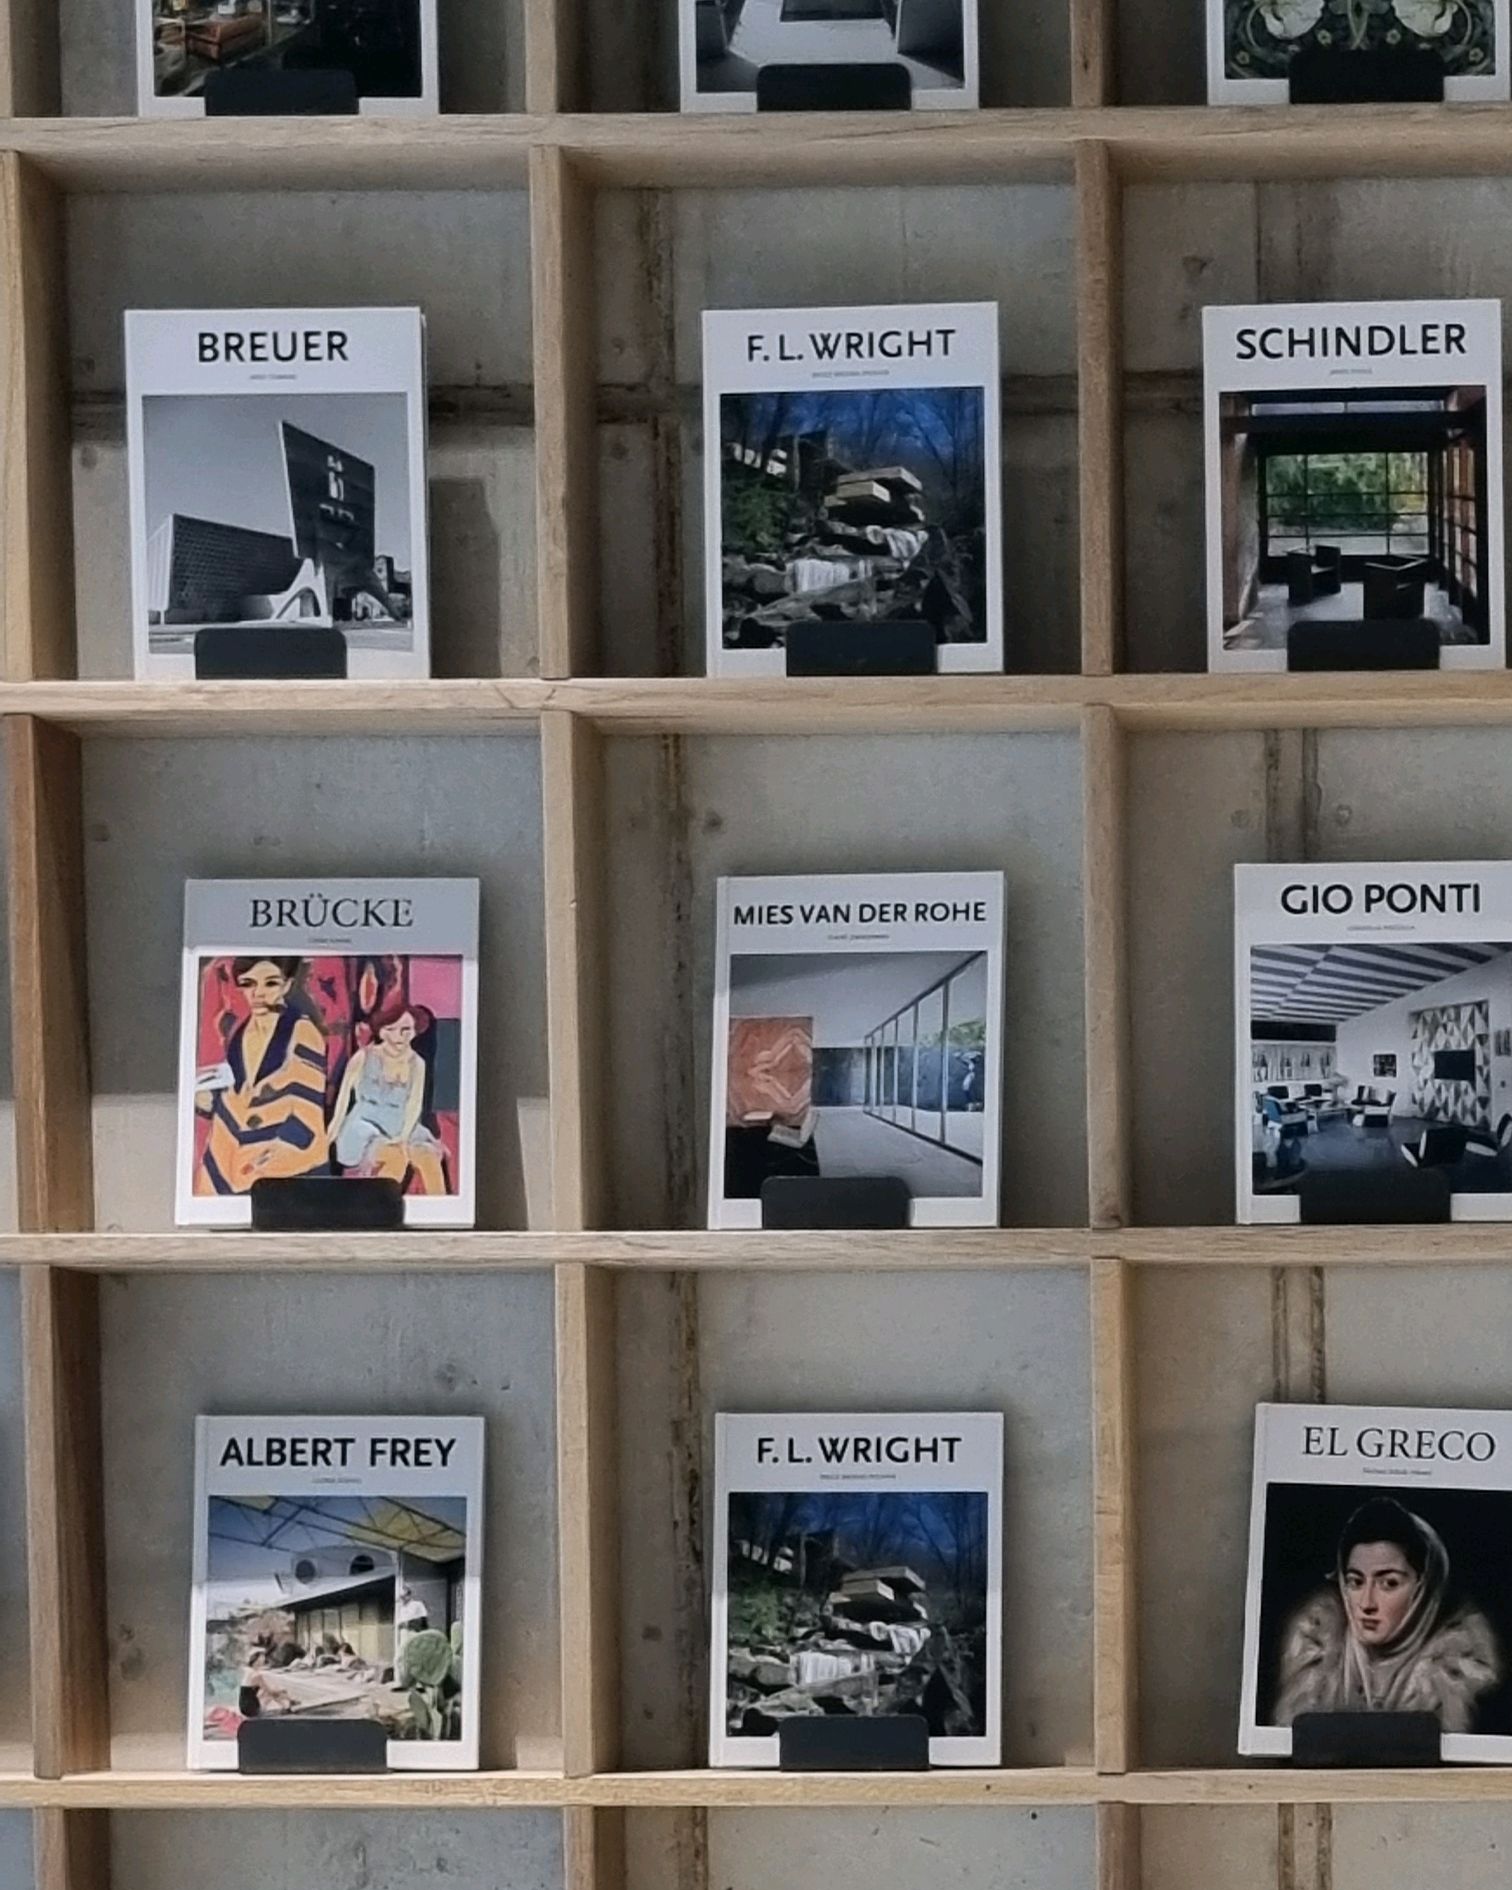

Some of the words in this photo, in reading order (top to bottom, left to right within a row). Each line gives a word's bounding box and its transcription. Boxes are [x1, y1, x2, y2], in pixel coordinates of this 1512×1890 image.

[198, 330, 350, 363] BREUER
[1234, 323, 1467, 360] SCHINDLER
[248, 892, 415, 928] BRÜCKE
[733, 904, 794, 926] MIES
[799, 903, 851, 925] VAN
[858, 902, 908, 924] DER
[914, 901, 988, 923] ROHE
[1280, 883, 1354, 915] GIO
[1364, 882, 1482, 914] PONTI
[218, 1436, 358, 1468] ALBERT
[369, 1437, 458, 1468] FREY
[1302, 1425, 1349, 1457] EL
[1355, 1427, 1496, 1463] GRECO
